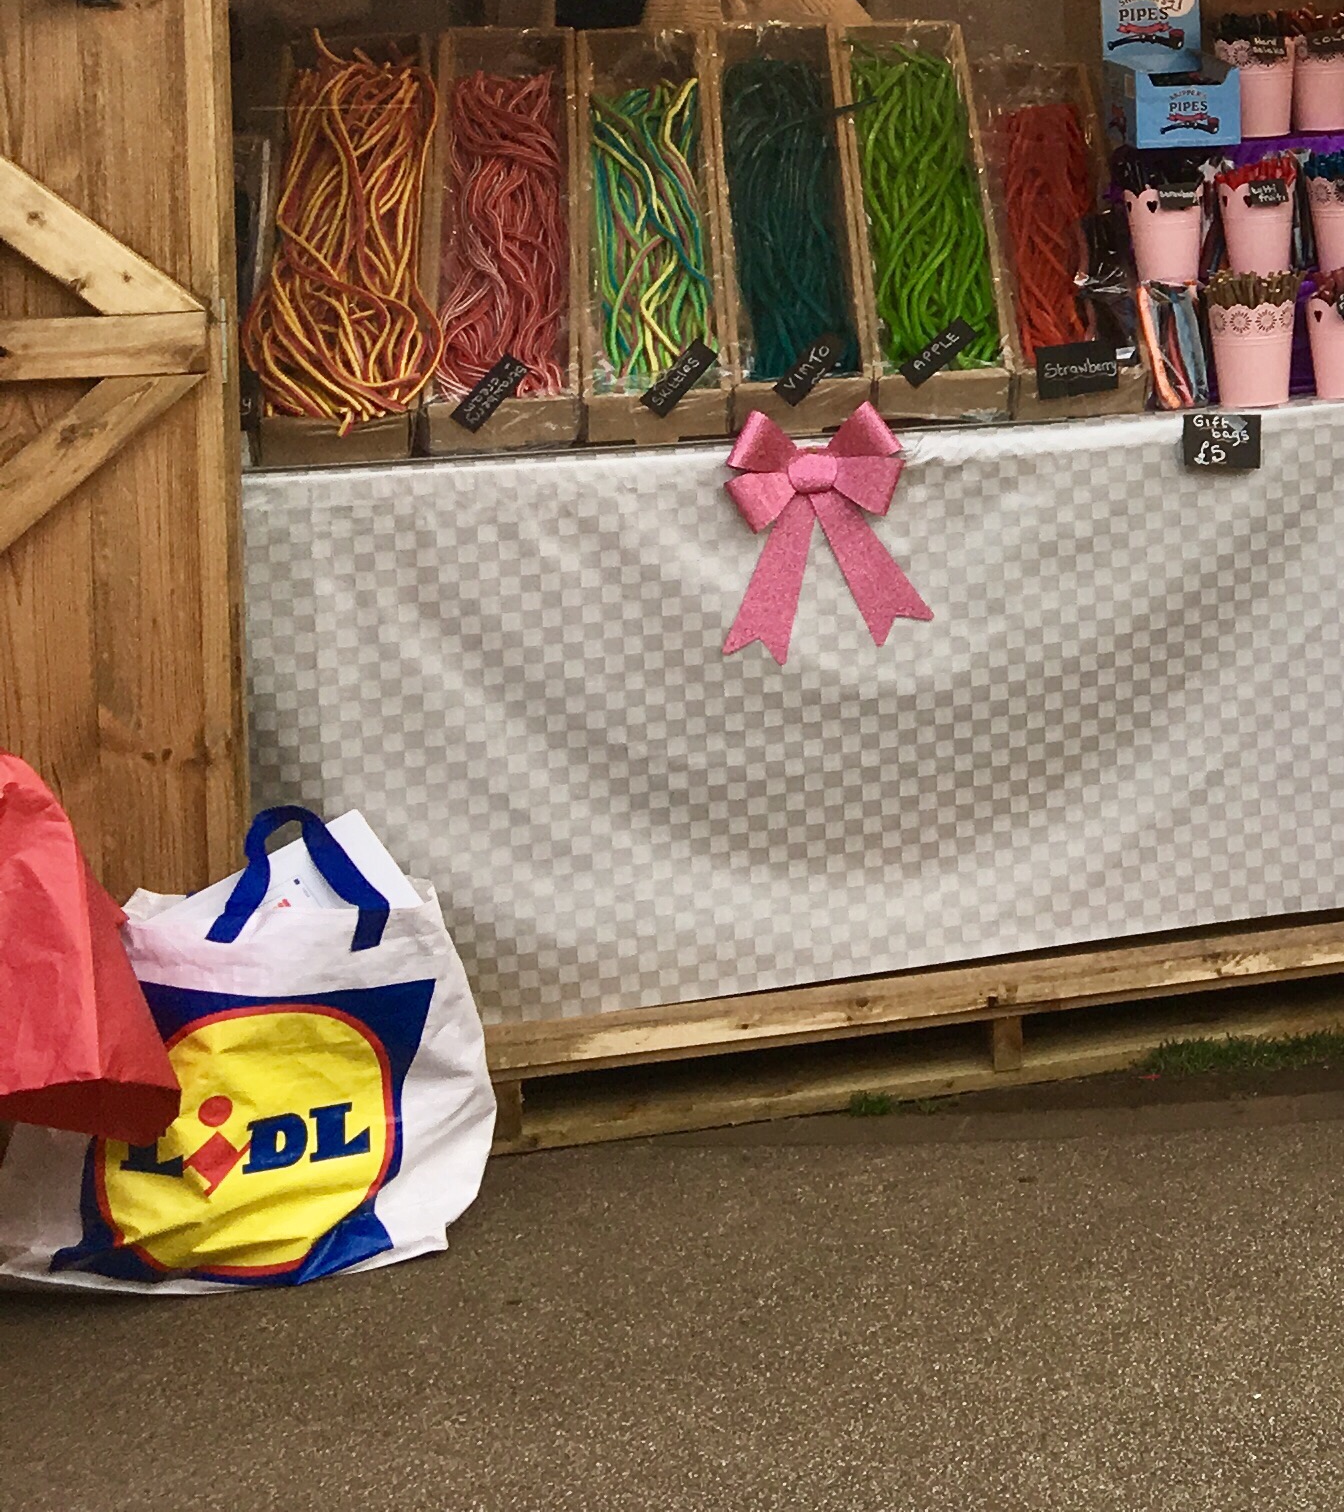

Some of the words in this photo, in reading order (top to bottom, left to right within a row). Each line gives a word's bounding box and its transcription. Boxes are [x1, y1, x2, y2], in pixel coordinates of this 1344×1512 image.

[1118, 6, 1170, 23] PIPES
[1169, 100, 1208, 112] PIPES
[912, 332, 960, 371] APPLE
[783, 345, 831, 390] VIMTO
[1043, 357, 1117, 379] Strawberry
[1193, 414, 1229, 429] Gift
[1211, 428, 1250, 447] bags
[1193, 441, 1227, 465] £5
